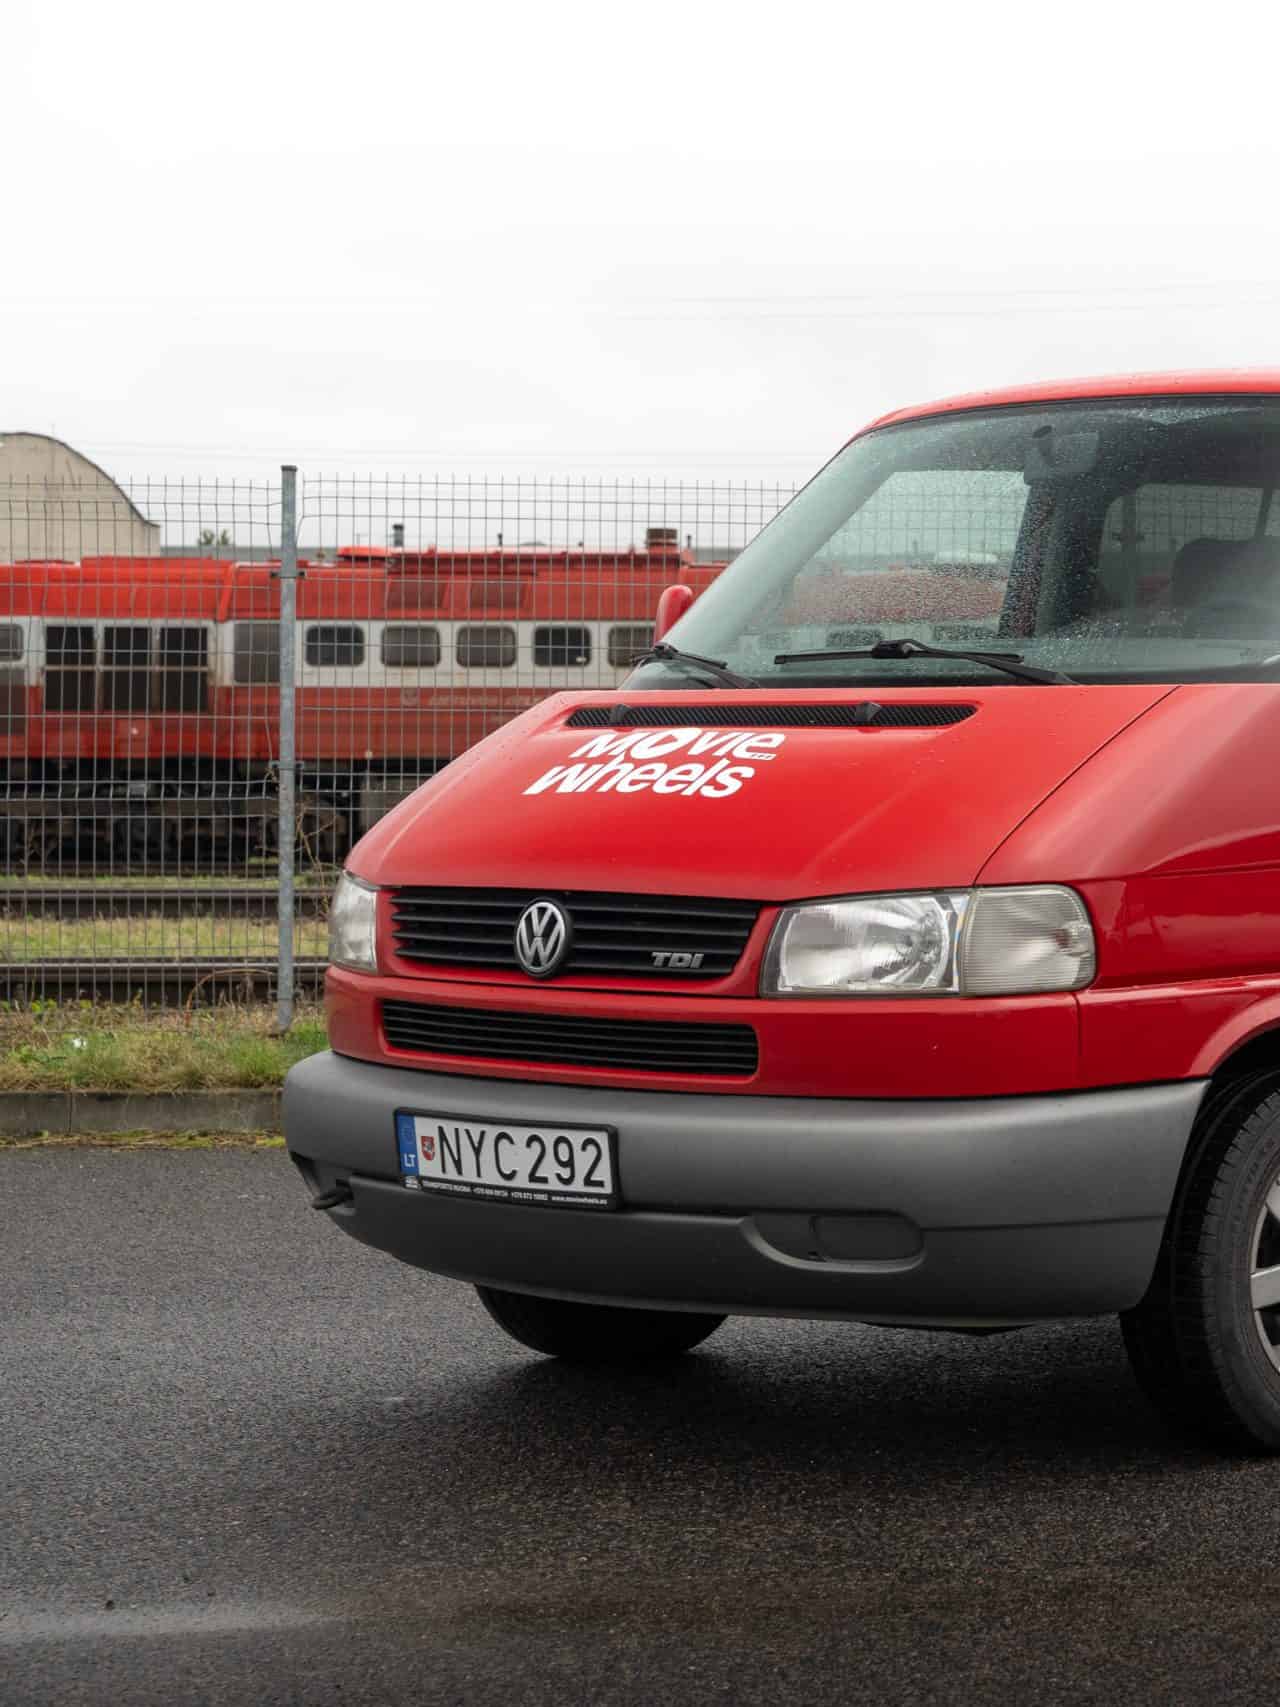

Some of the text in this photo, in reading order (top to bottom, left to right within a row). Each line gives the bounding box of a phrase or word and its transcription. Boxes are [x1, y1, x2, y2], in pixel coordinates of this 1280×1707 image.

[516, 901, 565, 972] VW
[651, 951, 704, 969] TDI
[404, 1153, 417, 1168] LT
[437, 1125, 606, 1188] NYC292
